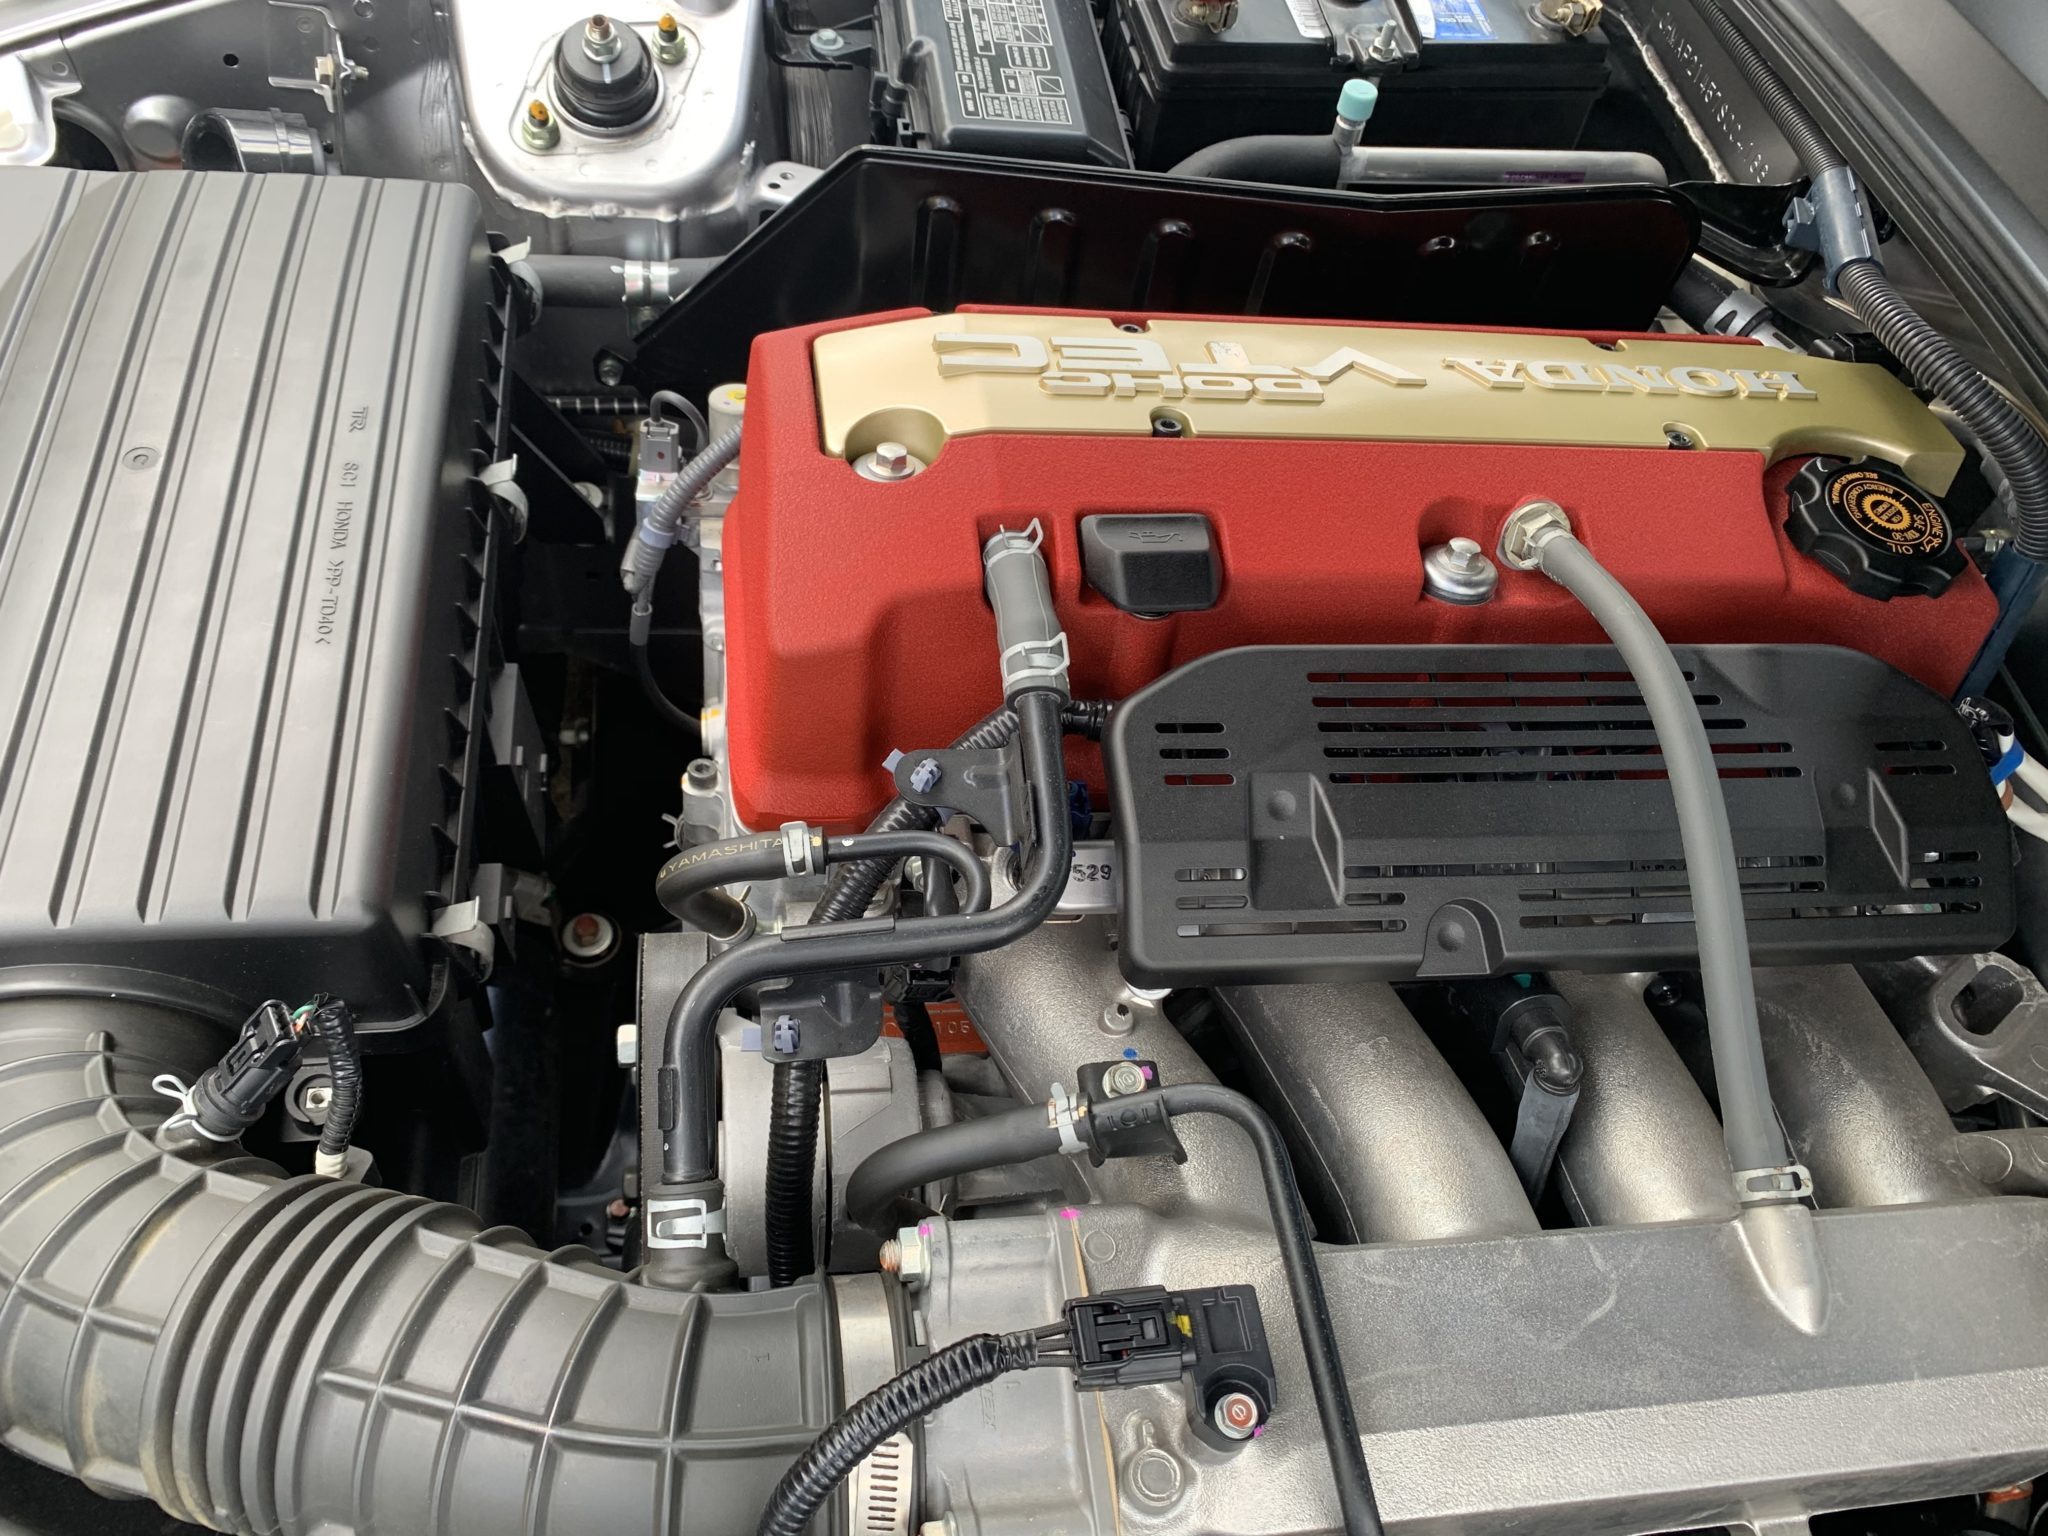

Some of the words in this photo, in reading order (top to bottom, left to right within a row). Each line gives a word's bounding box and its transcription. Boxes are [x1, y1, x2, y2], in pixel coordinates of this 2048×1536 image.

[932, 331, 1427, 385] VTEC
[1039, 370, 1324, 402] DOHC
[1441, 357, 1818, 400] HONDA
[1847, 485, 1864, 519] CONSERVING
[1863, 483, 1893, 495] ENERGY
[329, 501, 354, 550] HONDA
[1913, 513, 1925, 531] SAE
[1921, 502, 1944, 538] ENGINE
[1886, 542, 1913, 555] OIL
